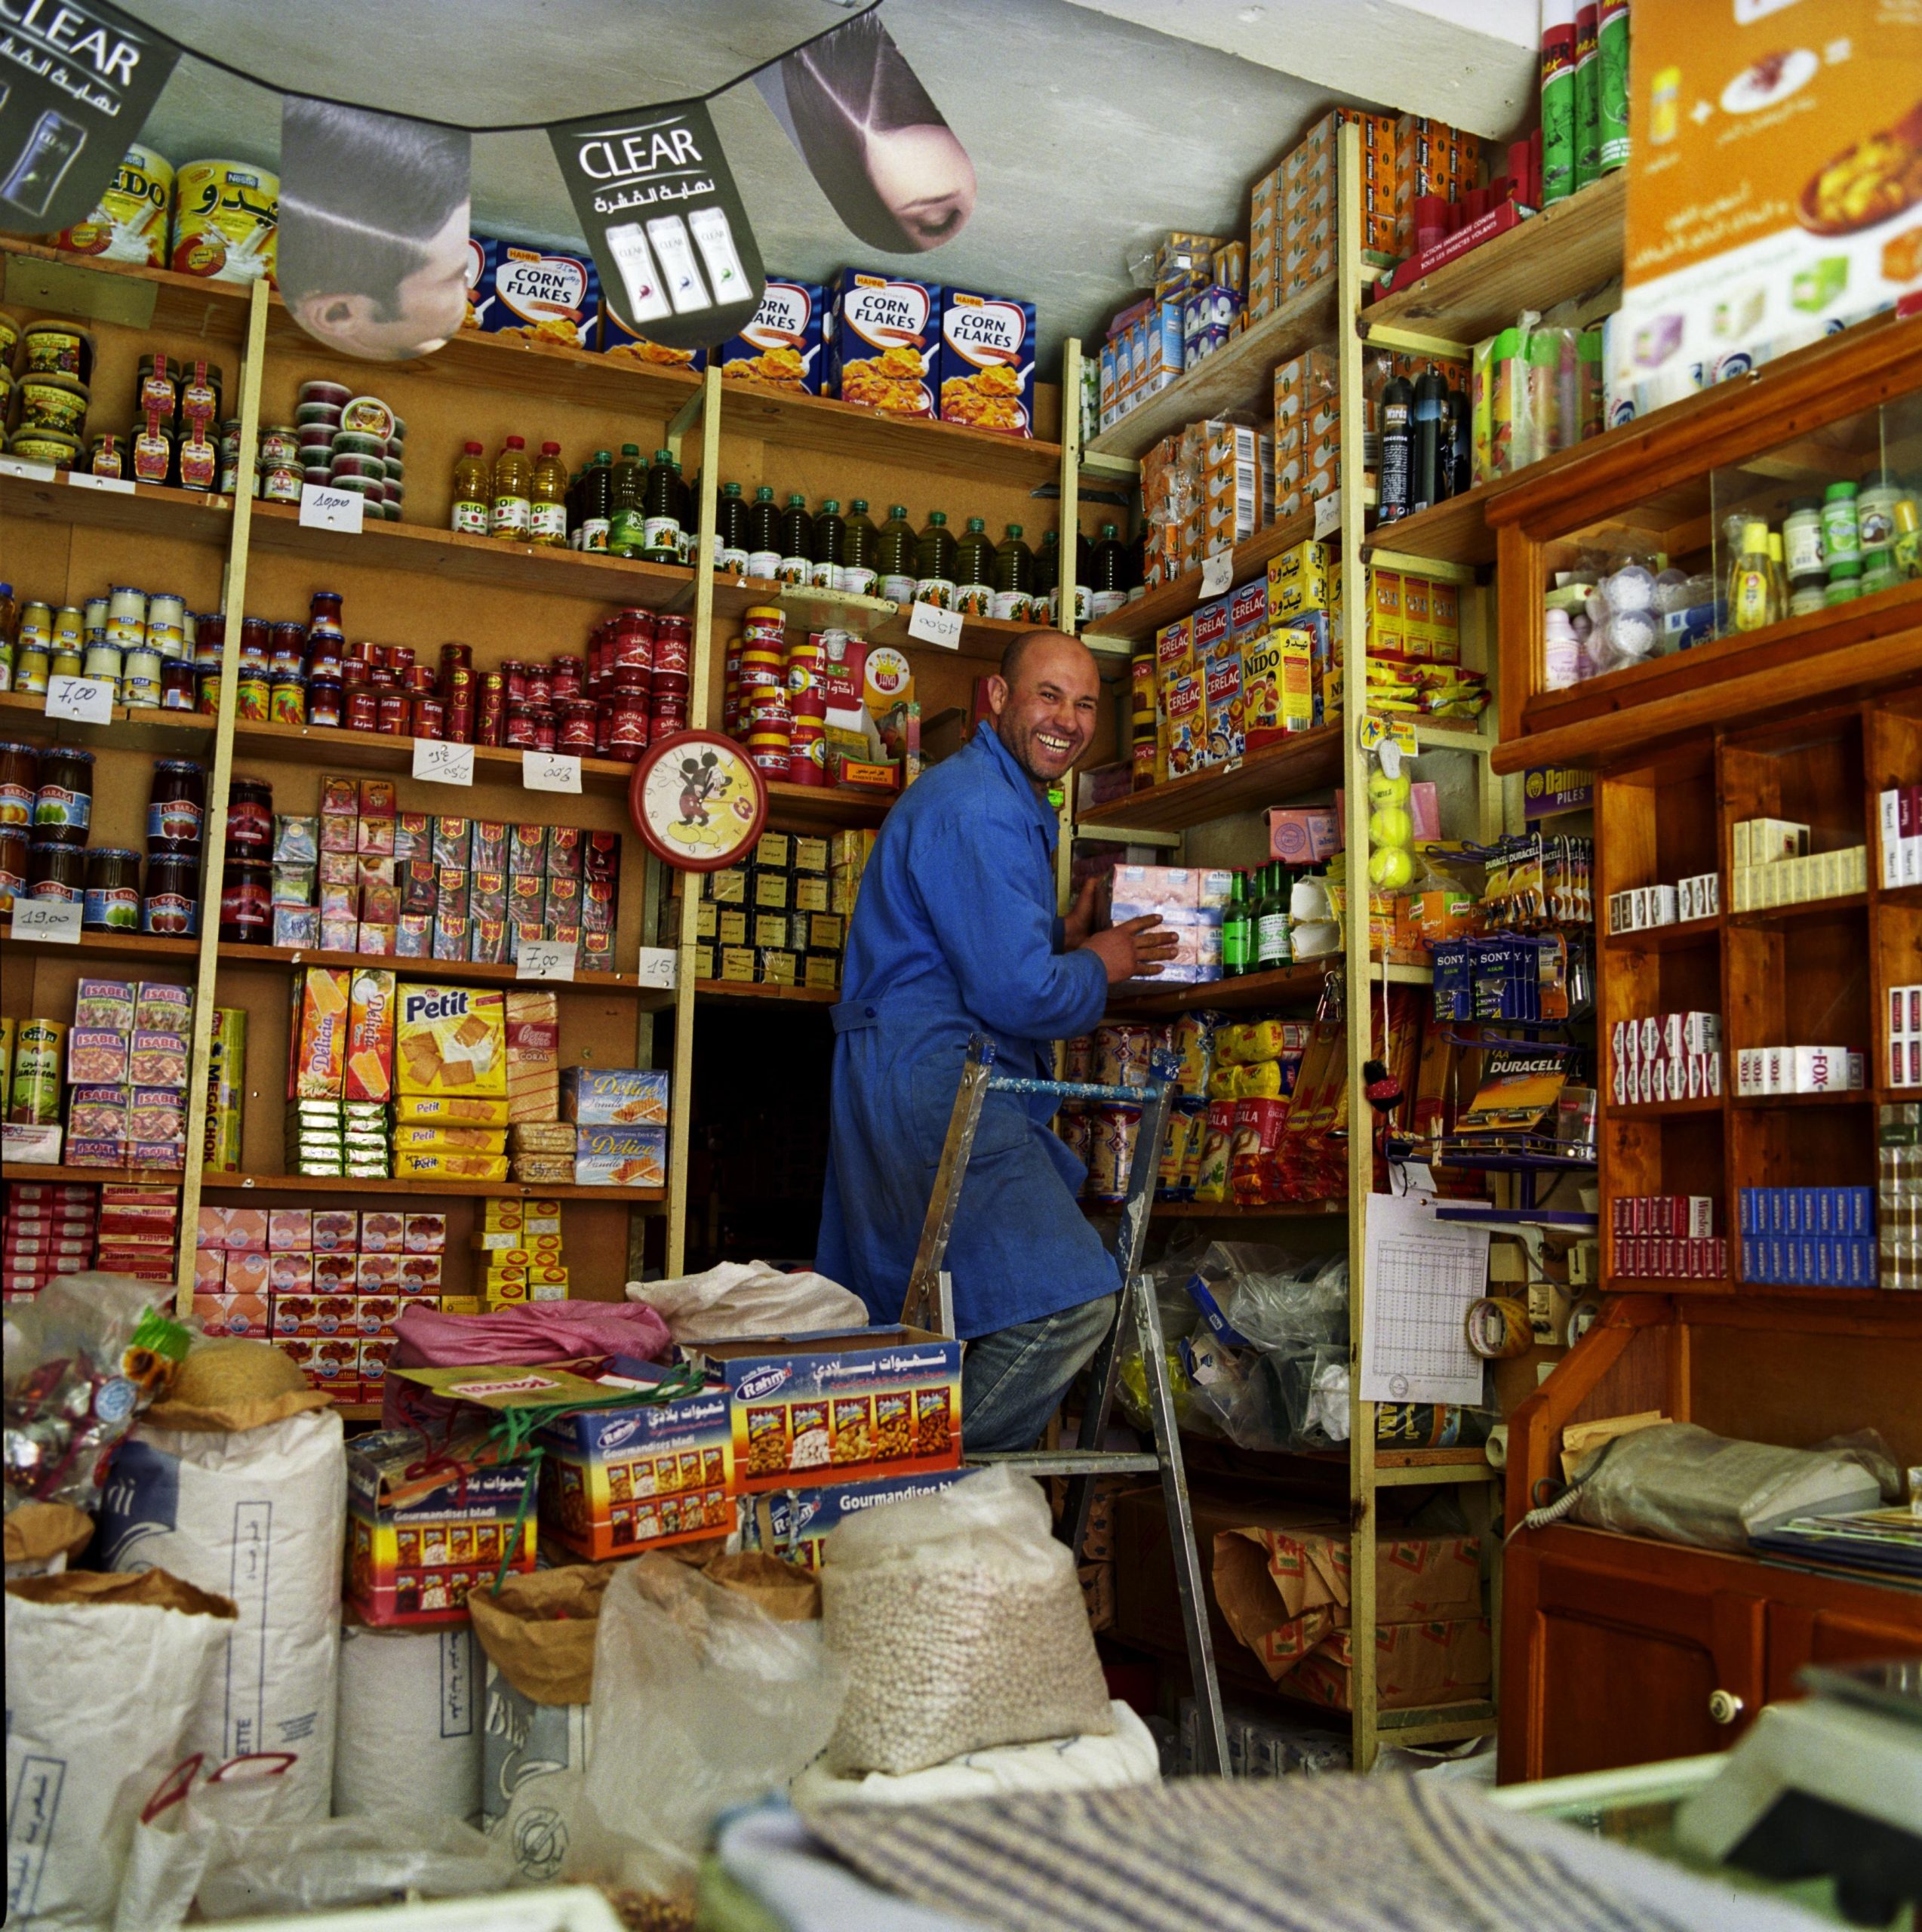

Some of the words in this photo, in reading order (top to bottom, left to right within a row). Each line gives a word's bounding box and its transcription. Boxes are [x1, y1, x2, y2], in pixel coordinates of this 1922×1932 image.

[579, 128, 703, 180] CLEAR
[228, 174, 257, 187] Nestlé
[661, 179, 715, 204] نهاية
[594, 189, 660, 214] القشرة
[1422, 243, 1442, 260] ACTION
[1443, 225, 1472, 248] IMMEDIATE
[1474, 211, 1496, 230] CONTRE
[1421, 257, 1435, 269] TOUS
[1436, 251, 1445, 262] LES
[1446, 237, 1471, 256] INSECTES
[1471, 221, 1497, 240] VOLANTS
[509, 250, 540, 262] HAHNE
[515, 269, 565, 288] CORN
[857, 275, 886, 288] HAHNE
[506, 281, 572, 303] FLAKES
[955, 295, 984, 306] HAHNE
[757, 299, 789, 315] ORN
[863, 295, 909, 314] CORN
[753, 315, 797, 331] AKES
[854, 309, 916, 330] FLAKES
[961, 315, 1006, 333] CORN
[953, 327, 1013, 348] FLAKES
[1387, 408, 1407, 420] Warda
[312, 492, 351, 509] 10,00
[1231, 595, 1265, 620] CERELAC
[918, 617, 958, 635] 45,00
[1194, 614, 1228, 639] CERELAC
[665, 641, 687, 653] AICHA
[1158, 635, 1189, 657] CERELAC
[343, 660, 364, 669] Soraya
[1244, 650, 1280, 677] NIDO
[371, 672, 391, 681] Soraya
[1207, 671, 1240, 696] CERELAC
[59, 681, 97, 704] 7,00
[1168, 688, 1201, 709] CERELAC
[381, 700, 400, 708] Soraya
[618, 712, 642, 723] AICHA
[1557, 788, 1585, 805] PILES
[733, 796, 754, 821] 3
[1509, 846, 1540, 863] DURACELL
[39, 884, 72, 900] BARAKA
[20, 910, 69, 925] 19,00
[1471, 906, 1487, 917] Dou
[526, 947, 559, 969] 7,00
[1437, 954, 1465, 966] SONY
[1480, 951, 1511, 964] SONY
[85, 985, 129, 999] ISABEL
[144, 989, 188, 1003] ISABEL
[406, 991, 469, 1023] Petit
[365, 994, 386, 1049] Délicia
[22, 1028, 54, 1041] Gala
[77, 1033, 122, 1047] ISABEL
[138, 1036, 183, 1051] ISABEL
[1702, 1016, 1714, 1054] Marlboro
[312, 1016, 334, 1072] Délicia
[519, 1052, 549, 1062] CORAL
[1489, 1058, 1563, 1074] DURACELL
[1740, 1060, 1749, 1082] FOX
[1753, 1060, 1762, 1082] FOX
[1770, 1058, 1779, 1081] FOX
[1812, 1055, 1828, 1085] FOX
[78, 1090, 123, 1103] ISABEL
[137, 1093, 183, 1106] ISABEL
[204, 1064, 221, 1164] MEGACHOK
[417, 1101, 440, 1113] Petit
[412, 1130, 435, 1141] Petit
[78, 1143, 114, 1154] ISABEL
[138, 1146, 175, 1157] ISABEL
[589, 1134, 656, 1156] Délice
[414, 1158, 439, 1170] Petit
[107, 1187, 140, 1195] ISABEL
[1697, 1200, 1710, 1237] Winston
[879, 1350, 947, 1371] شهيوات
[812, 1360, 877, 1383] بلادي
[743, 1367, 793, 1399] Rahma
[647, 1408, 678, 1429] بلادي
[681, 1399, 725, 1420] شهيوات
[603, 1440, 671, 1459] Gourmandises
[671, 1434, 695, 1447] bladi
[393, 1508, 468, 1522] Gourmandises
[469, 1506, 497, 1518] bladi
